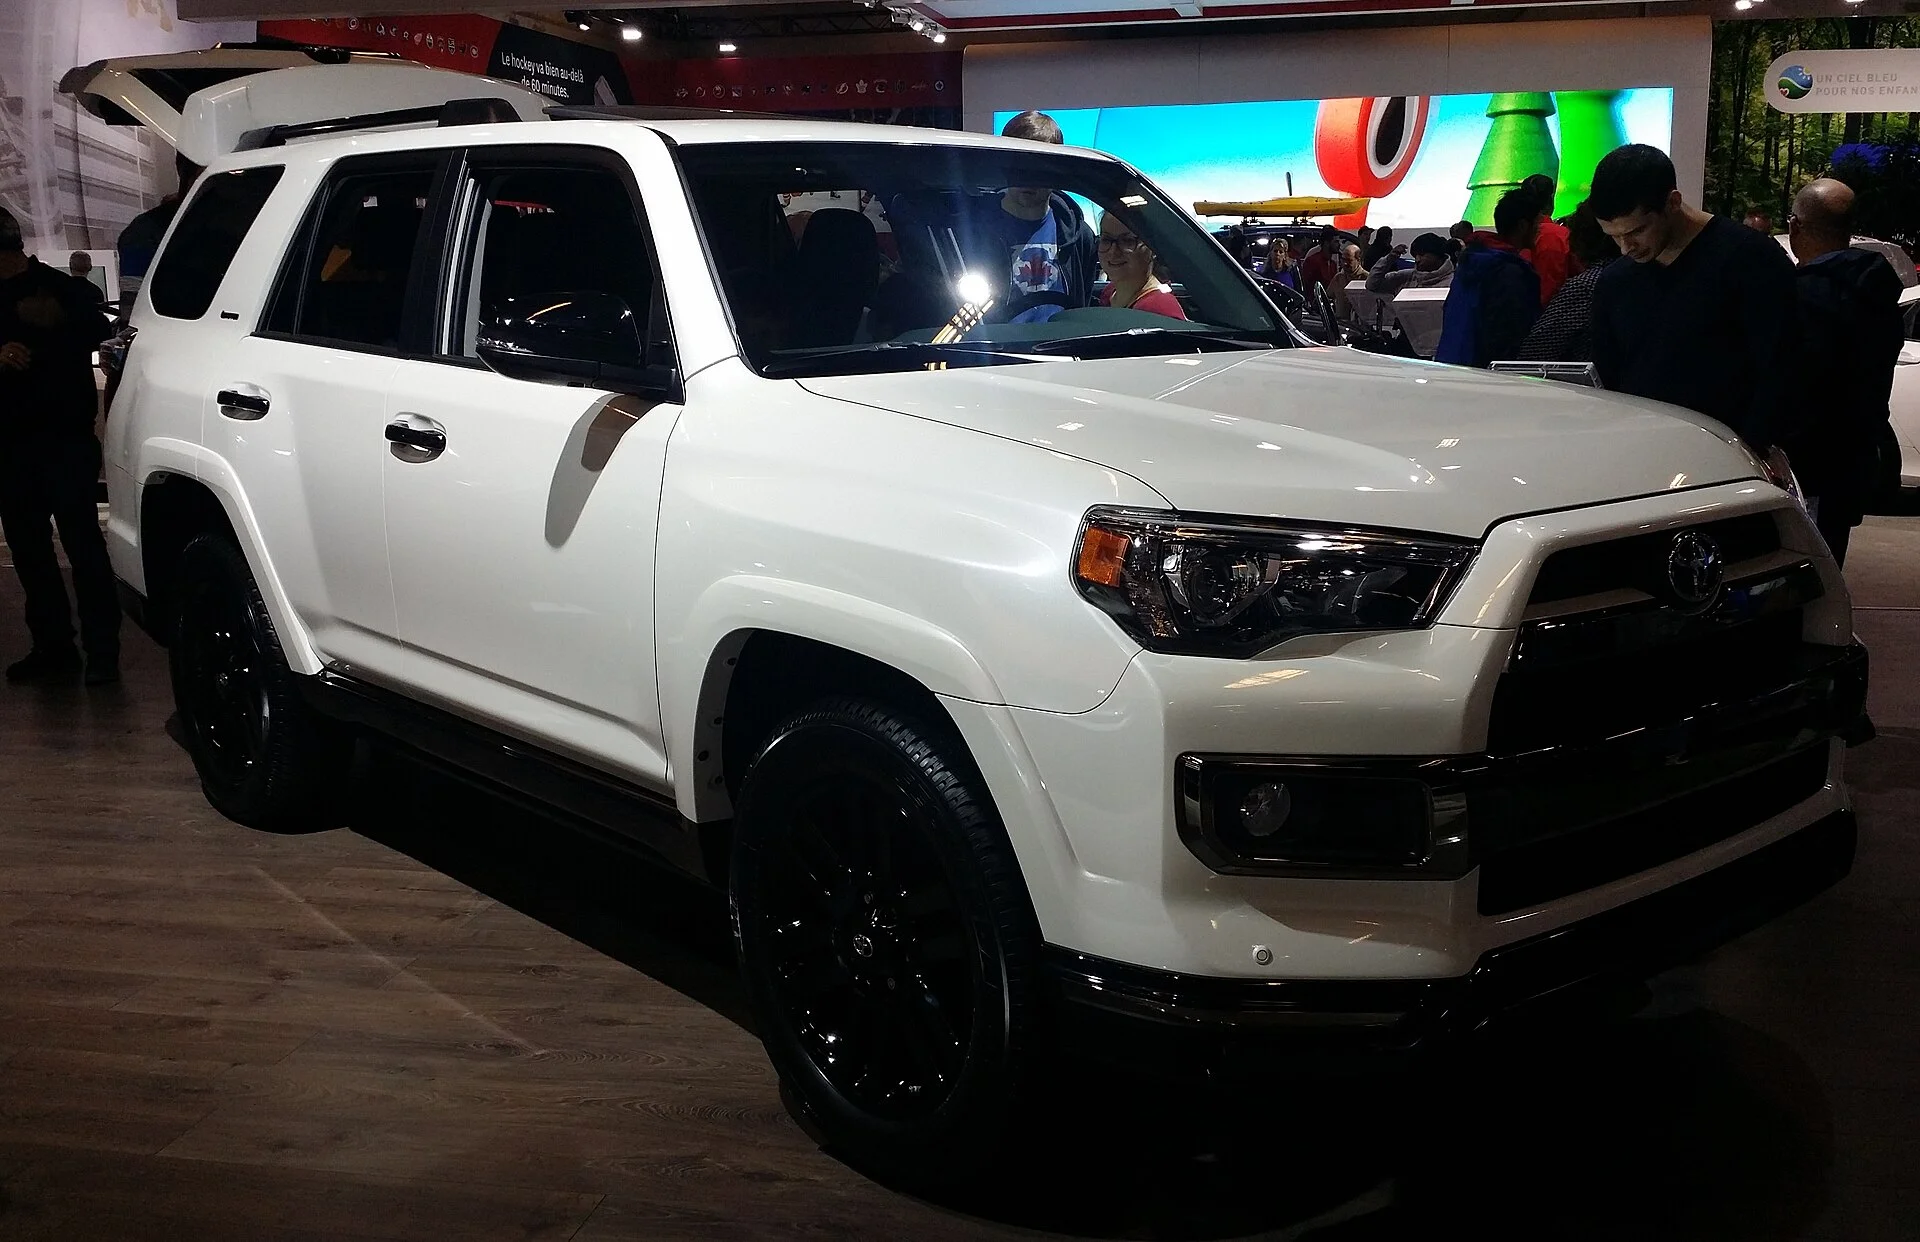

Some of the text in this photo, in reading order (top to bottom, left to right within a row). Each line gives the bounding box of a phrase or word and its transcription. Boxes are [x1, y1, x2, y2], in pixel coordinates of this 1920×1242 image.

[501, 52, 584, 83] Le hockey va bien au-delà
[1816, 73, 1898, 83] UN CIEL BLEU
[521, 75, 570, 99] de 60 minutes.
[1816, 86, 1920, 96] POUR NOS ENFAN
